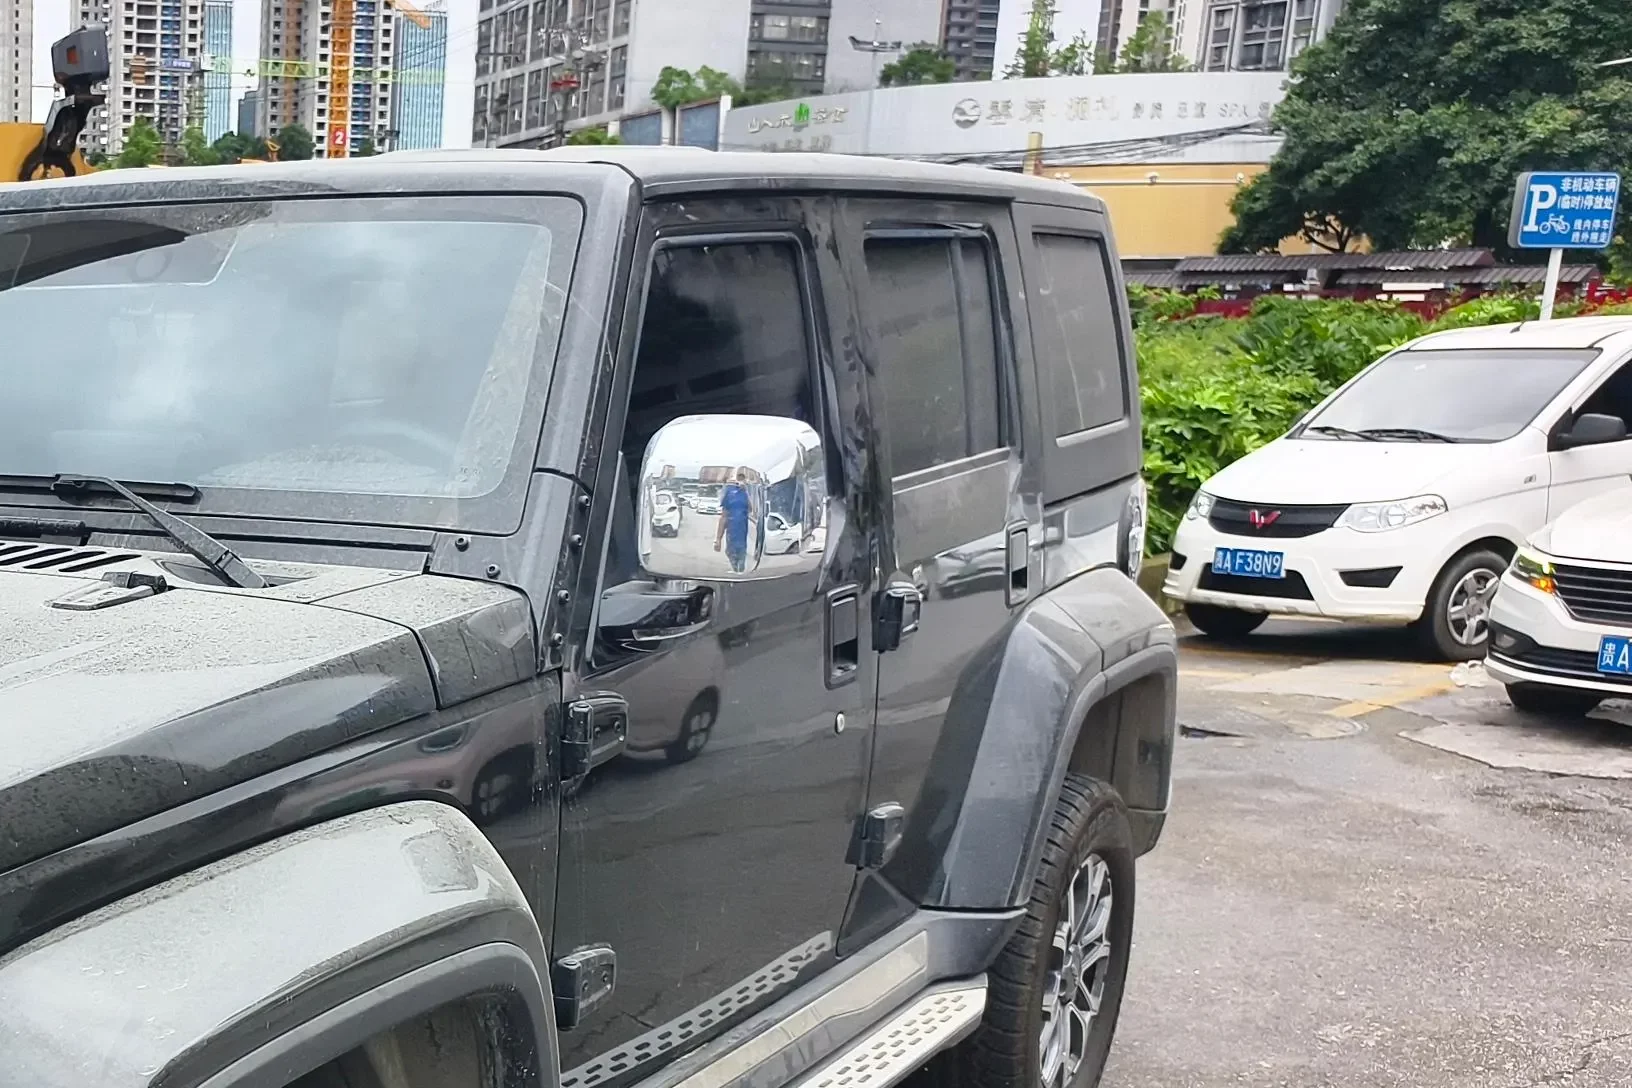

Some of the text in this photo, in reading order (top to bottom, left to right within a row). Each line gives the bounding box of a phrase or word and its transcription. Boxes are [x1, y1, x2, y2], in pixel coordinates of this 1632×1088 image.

[334, 131, 344, 145] 2
[1560, 177, 1617, 192] 非机动车辆
[1523, 184, 1557, 232] P
